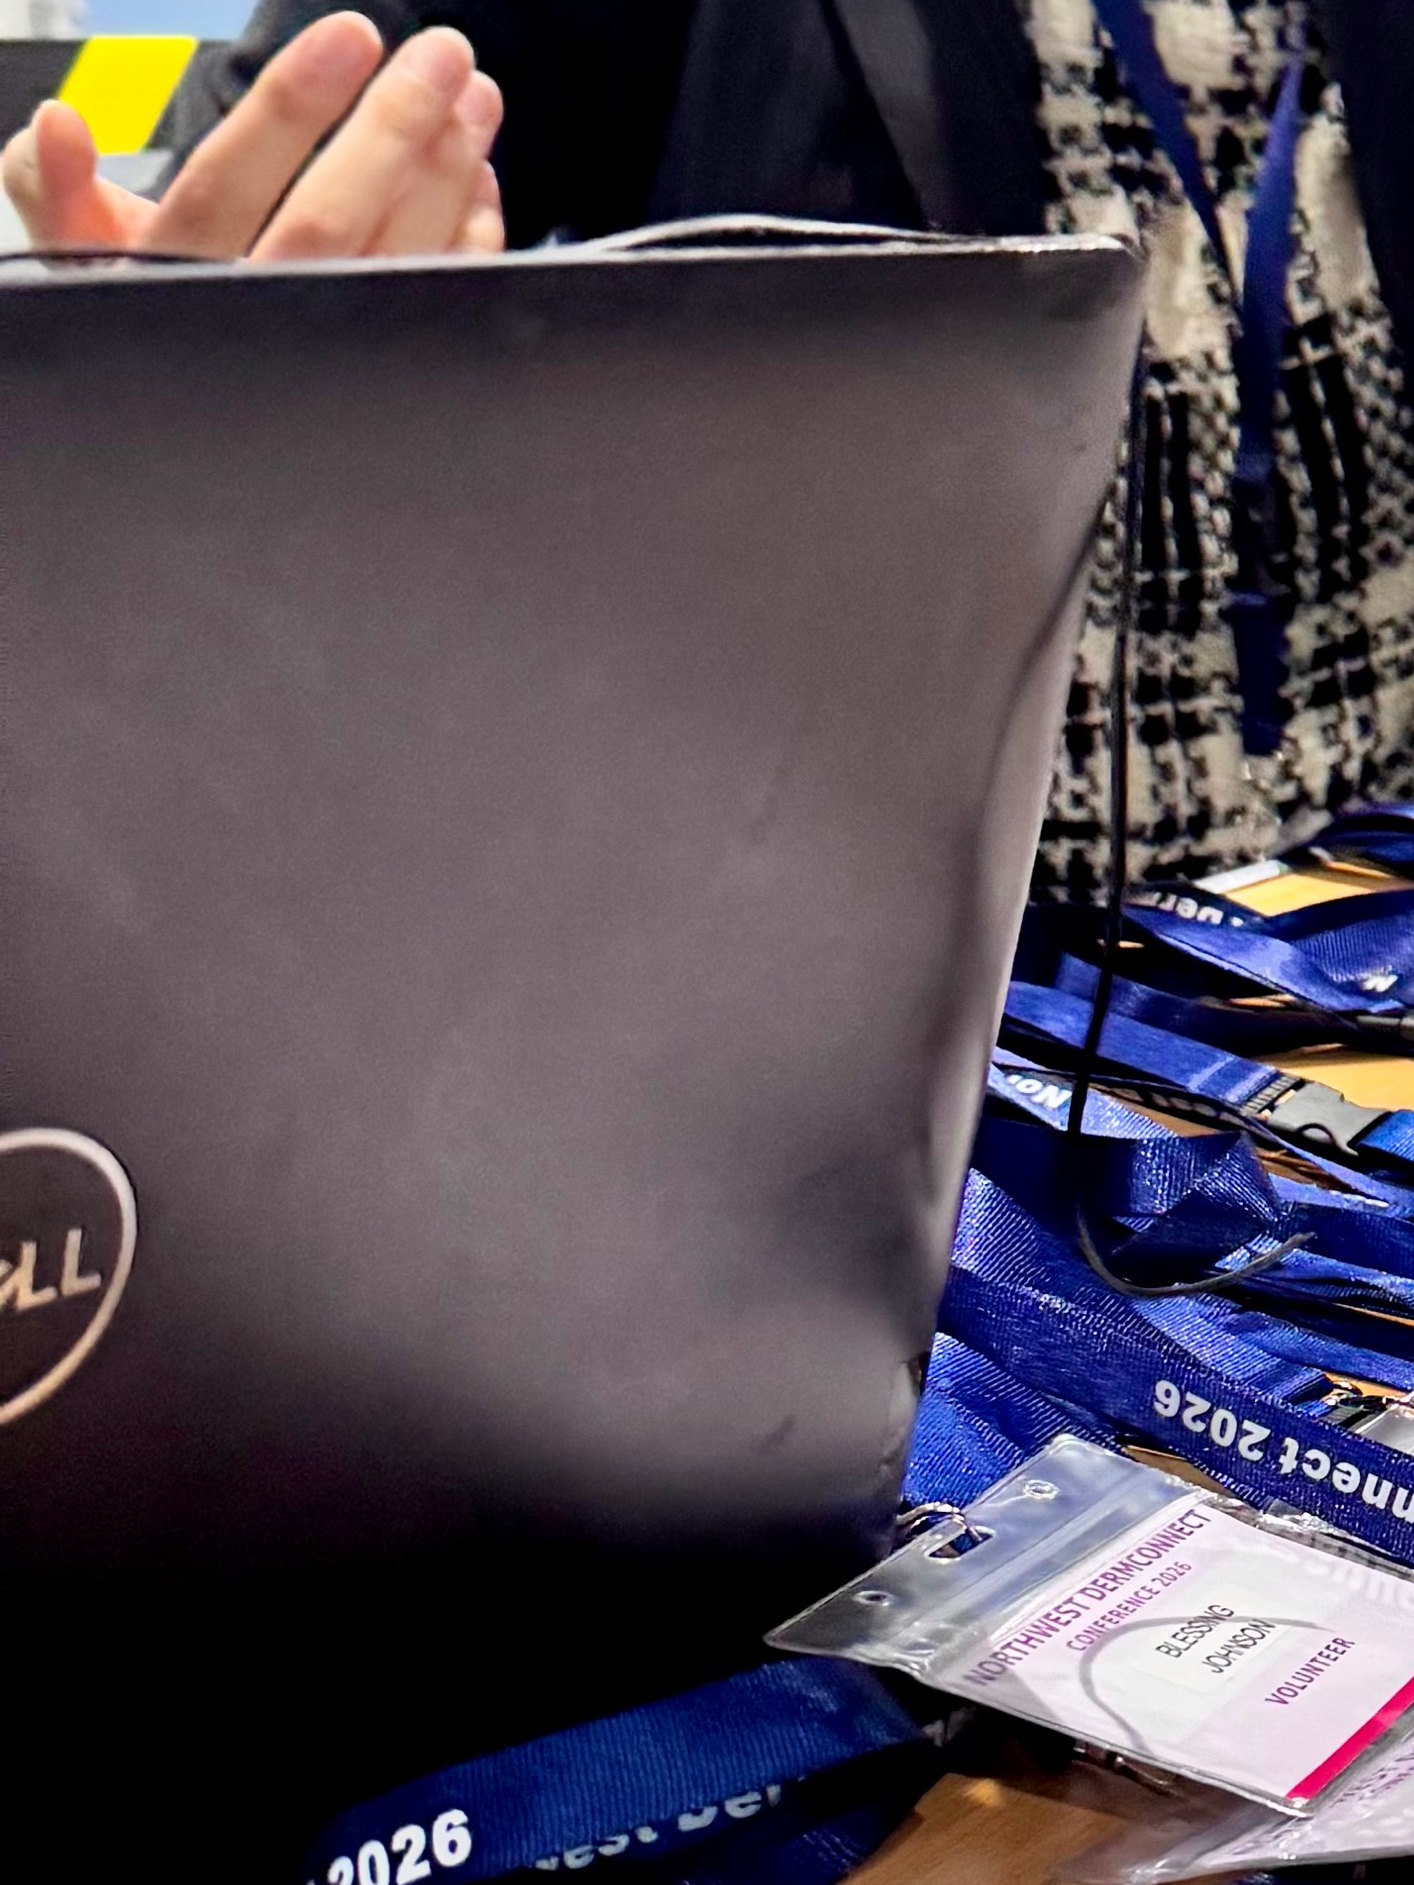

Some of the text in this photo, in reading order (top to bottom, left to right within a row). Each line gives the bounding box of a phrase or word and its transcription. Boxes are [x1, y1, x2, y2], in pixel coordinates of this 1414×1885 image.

[1153, 1378, 1276, 1462] 2026
[964, 1509, 1212, 1687] NORTHWEST DERMCONNECT
[1066, 1561, 1192, 1652] CONFERENCE 2026
[1155, 1603, 1234, 1660] BLESSING
[1201, 1618, 1276, 1675] JOHNSON
[1264, 1636, 1355, 1706] VOLUNTEER
